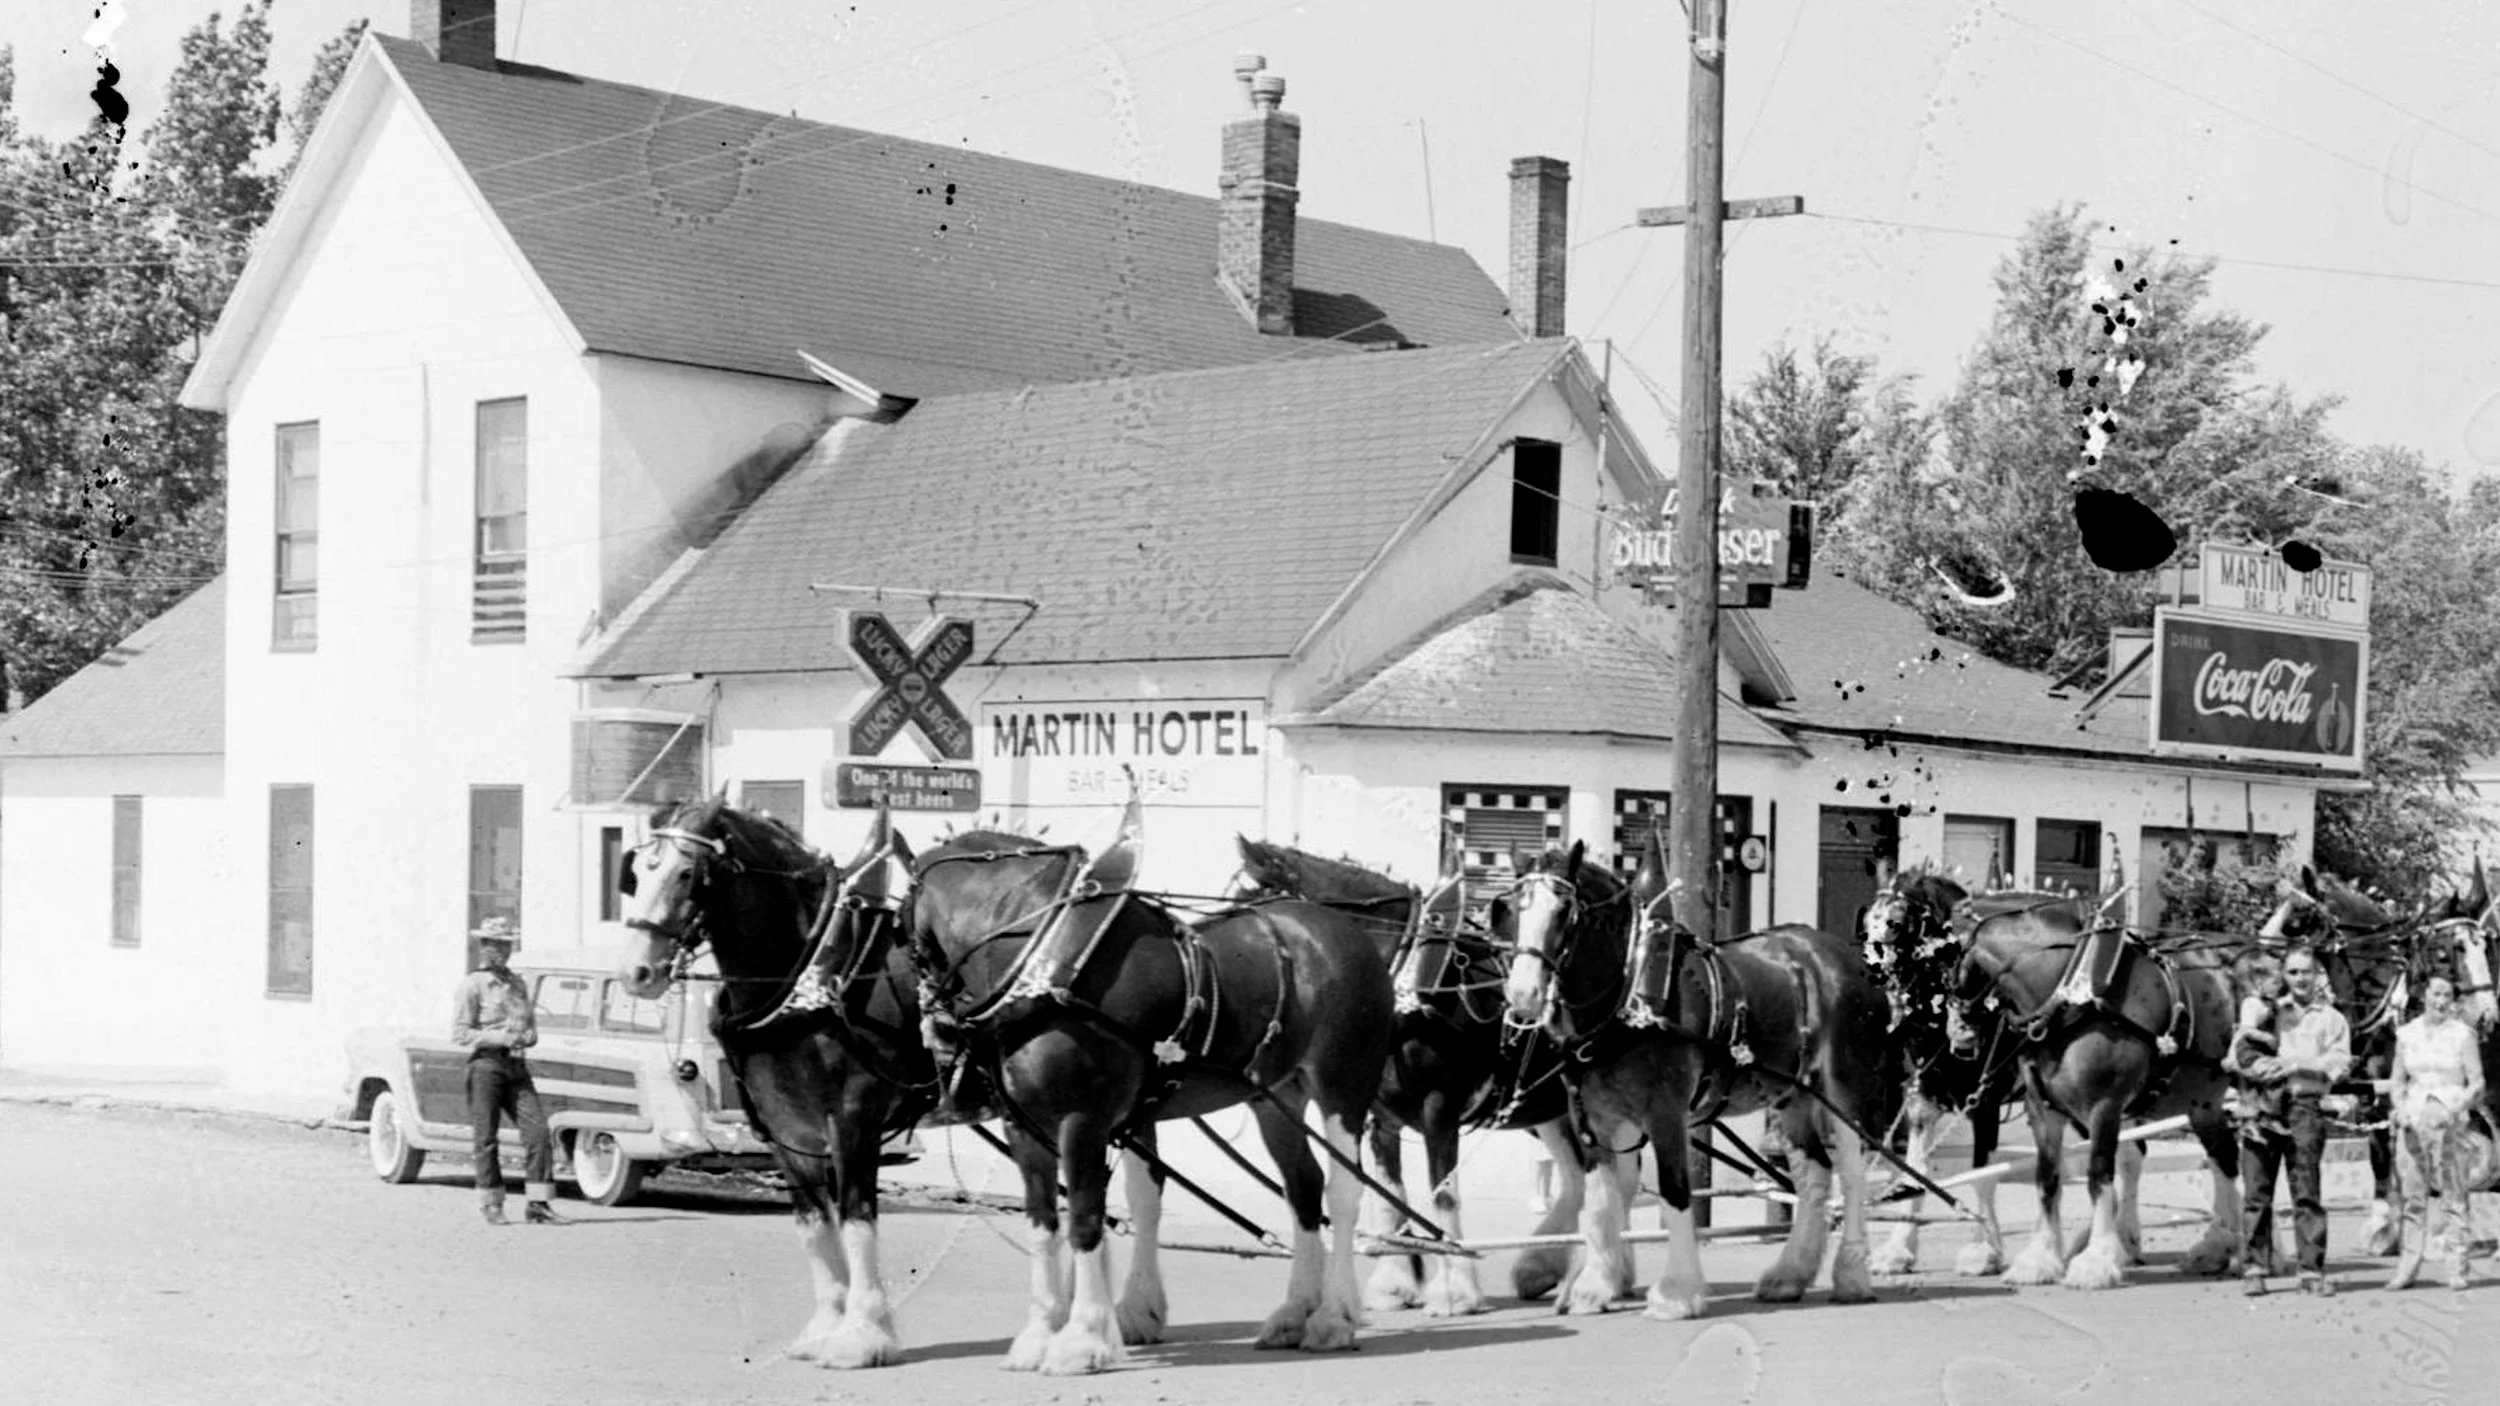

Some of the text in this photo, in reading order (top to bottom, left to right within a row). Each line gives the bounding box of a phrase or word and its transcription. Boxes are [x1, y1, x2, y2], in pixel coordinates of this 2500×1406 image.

[1613, 521, 1781, 566] Budiser
[2220, 554, 2357, 603] MARTIN HOTEL
[2170, 632, 2211, 650] DRINK
[859, 627, 968, 748] LUCKY LAGER
[860, 621, 968, 753] LUCKY LAGER
[2194, 651, 2318, 724] Coca-Cola
[993, 710, 1259, 757] MARTIN HOTEL
[851, 767, 879, 786] One
[902, 770, 923, 788] the
[1068, 769, 1105, 792] BAR
